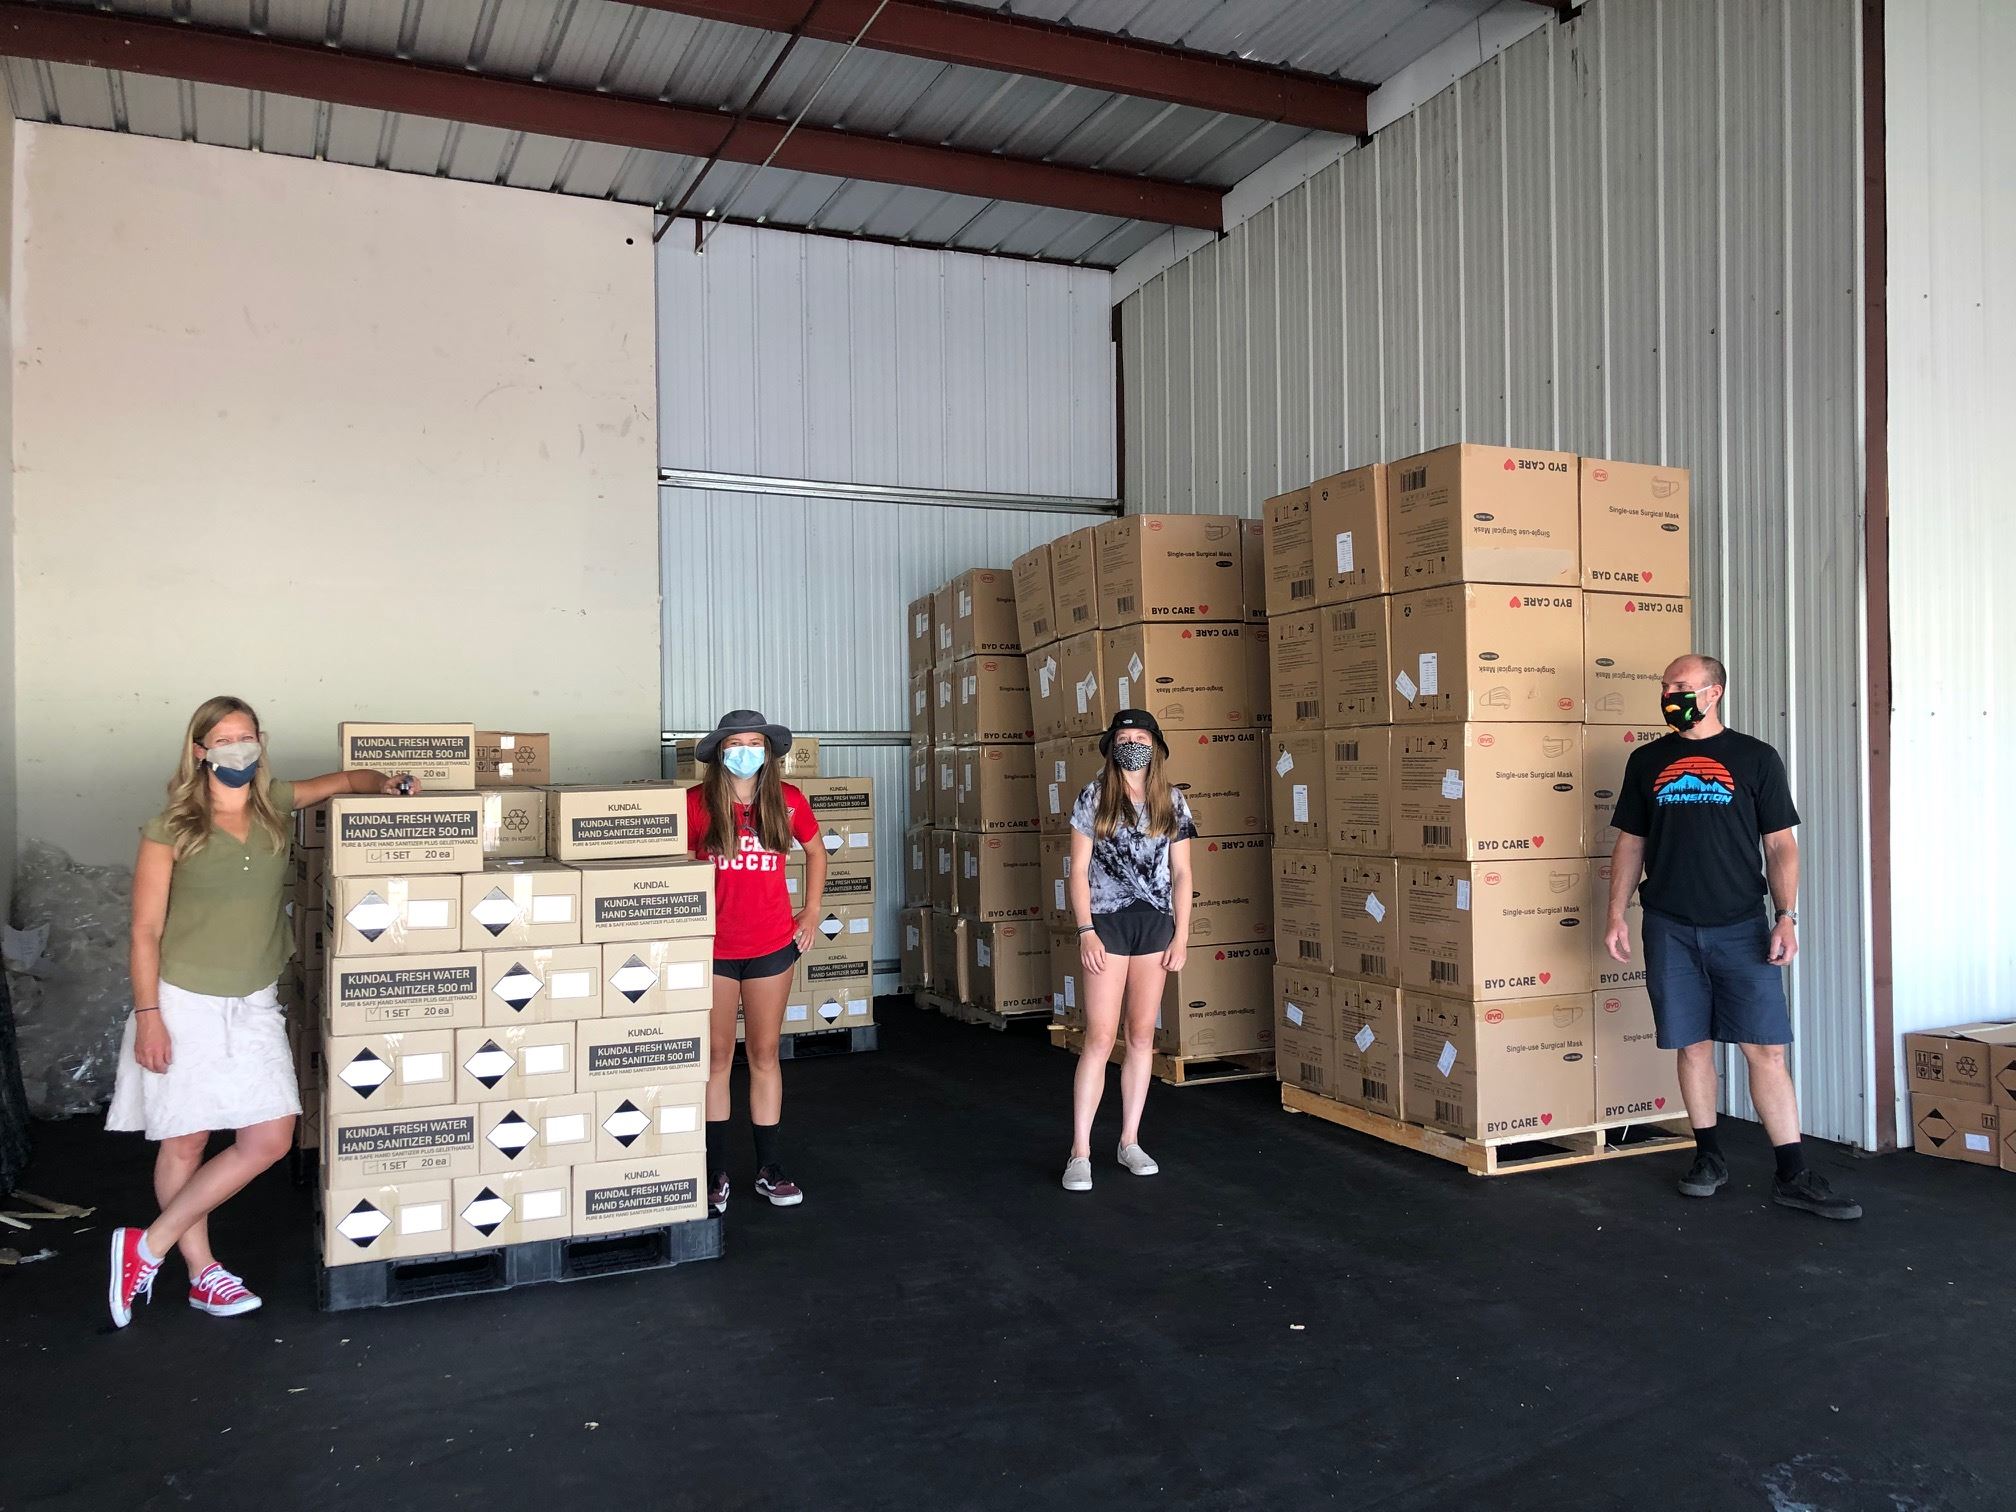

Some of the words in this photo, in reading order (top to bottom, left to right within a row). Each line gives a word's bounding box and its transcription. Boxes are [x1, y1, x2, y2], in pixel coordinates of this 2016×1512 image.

[1519, 460, 1545, 469] CARE
[1549, 463, 1567, 472] BYD
[1609, 506, 1639, 516] Single-use
[1641, 509, 1662, 518] Surgical
[1592, 571, 1610, 580] BYD
[1614, 572, 1639, 582] CARE
[1524, 598, 1550, 606] CARE
[1554, 599, 1572, 607] BYD
[1638, 602, 1662, 611] CARE
[1666, 604, 1683, 612] BYD
[1638, 732, 1660, 740] CARE
[1496, 771, 1528, 779] Single-use
[1656, 794, 1732, 803] TRANSITION
[349, 816, 393, 824] KUNDAL
[396, 815, 431, 824] FRESH
[434, 814, 470, 823] WATER
[580, 820, 614, 828] KUNDAL
[615, 818, 642, 826] FRESH
[643, 817, 670, 825] WATER
[346, 829, 377, 837] HAND
[380, 828, 435, 837] SANITIZER
[438, 828, 458, 836] 500
[461, 827, 473, 836] ml
[578, 830, 602, 838] HAND
[604, 828, 644, 837] SANITIZER
[647, 827, 661, 835] 500
[1222, 841, 1244, 849] CARE
[1247, 840, 1264, 848] BYD
[1479, 840, 1498, 850] BYD
[1502, 839, 1529, 849] CARE
[393, 851, 410, 859] SET
[635, 881, 670, 889] KUNDAL
[604, 898, 640, 908] KUNDAL
[642, 897, 670, 905] FRESH
[671, 895, 699, 904] WATER
[602, 910, 627, 919] HAND
[630, 907, 672, 917] SANITIZER
[675, 906, 690, 914] 500
[692, 905, 701, 913] ml
[1503, 908, 1535, 916] Single-use
[1537, 907, 1562, 915] Surgical
[1228, 950, 1250, 958] CARE
[348, 974, 392, 984] KUNDAL
[395, 972, 430, 982] FRESH
[433, 970, 470, 980] WATER
[1485, 979, 1505, 988] BYD
[1509, 976, 1535, 986] CARE
[1601, 974, 1619, 983] BYD
[1623, 971, 1646, 980] CARE
[345, 988, 376, 997] HAND
[379, 985, 434, 995] SANITIZER
[437, 983, 457, 992] 500
[460, 983, 473, 991] ml
[392, 1008, 409, 1016] SET
[424, 1006, 436, 1014] 20
[629, 1027, 664, 1037] KUNDAL
[598, 1046, 633, 1056] KUNDAL
[635, 1043, 663, 1053] FRESH
[664, 1041, 692, 1050] WATER
[1507, 1044, 1539, 1053] Single-use
[1541, 1042, 1565, 1051] Surgical
[596, 1057, 620, 1067] HAND
[623, 1054, 665, 1065] SANITIZER
[668, 1052, 683, 1061] 500
[685, 1051, 694, 1059] ml
[1606, 1106, 1624, 1116] BYD
[1628, 1102, 1652, 1113] CARE
[345, 1127, 390, 1138] KUNDAL
[393, 1123, 428, 1134] FRESH
[431, 1120, 467, 1131] WATER
[1488, 1121, 1507, 1132] BYD
[1511, 1118, 1538, 1129] CARE
[342, 1141, 374, 1151] HAND
[377, 1136, 432, 1148] SANITIZER
[435, 1134, 455, 1143] 500
[458, 1132, 470, 1141] ml
[390, 1160, 407, 1168] SET
[422, 1158, 434, 1166] 20
[625, 1169, 661, 1180] KUNDAL
[594, 1189, 630, 1200] KUNDAL
[632, 1185, 660, 1196] FRESH
[661, 1182, 689, 1192] WATER
[592, 1201, 617, 1211] HAND
[620, 1195, 662, 1208] SANITIZER
[665, 1193, 679, 1203] 500
[682, 1192, 691, 1200] ml
